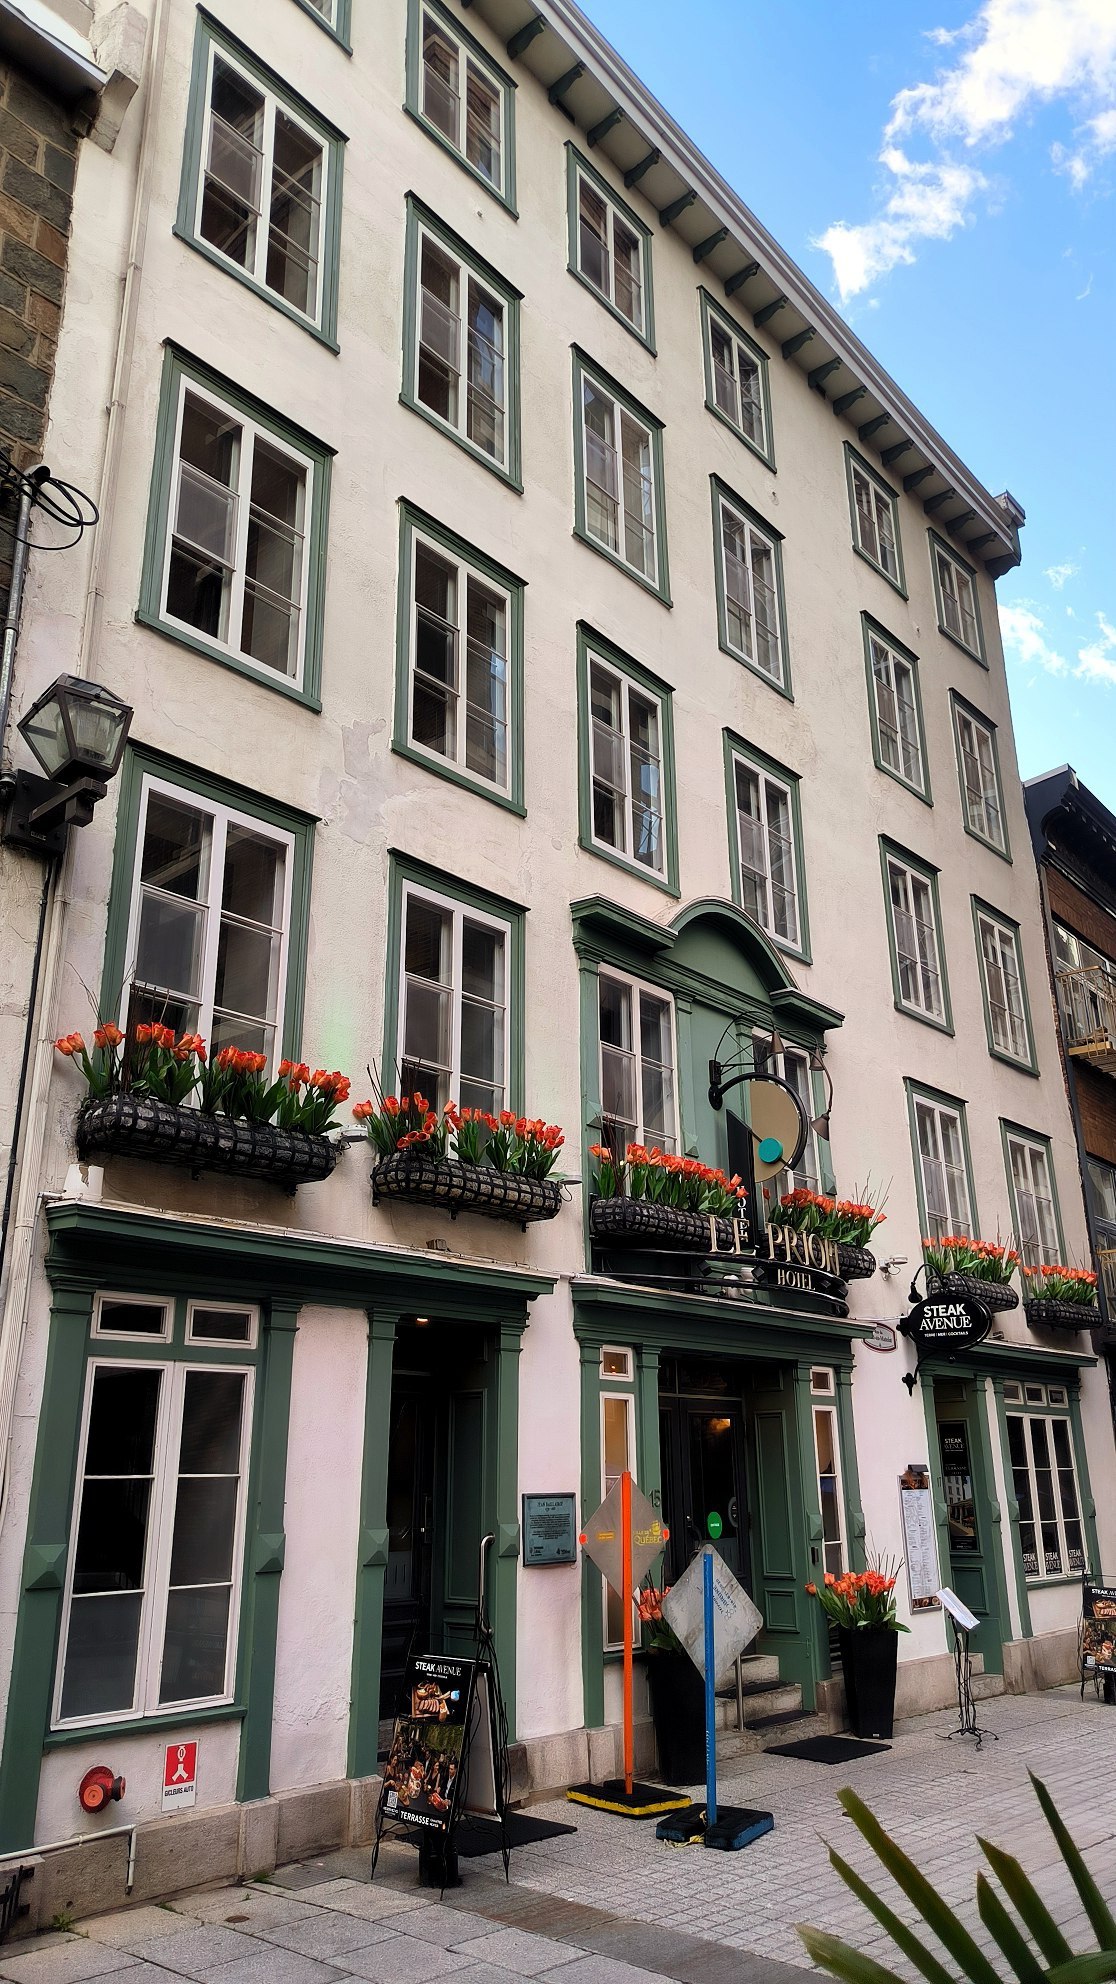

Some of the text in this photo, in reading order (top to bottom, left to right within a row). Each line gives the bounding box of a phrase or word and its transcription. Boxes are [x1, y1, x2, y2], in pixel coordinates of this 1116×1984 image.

[708, 1214, 756, 1256] LE
[777, 1268, 816, 1290] HOTEL
[923, 1303, 967, 1318] STEAK
[919, 1316, 973, 1331] AVENUE
[649, 1489, 661, 1508] 15
[634, 1535, 662, 1545] QUÉBEC
[1023, 1553, 1036, 1562] STEAK
[1045, 1552, 1059, 1561] STEAK
[1068, 1549, 1082, 1558] STEAK
[415, 1661, 436, 1672] STEAK
[435, 1664, 462, 1677] AVENUE
[183, 1785, 194, 1793] AUTO
[400, 1810, 430, 1826] TERRASSE
